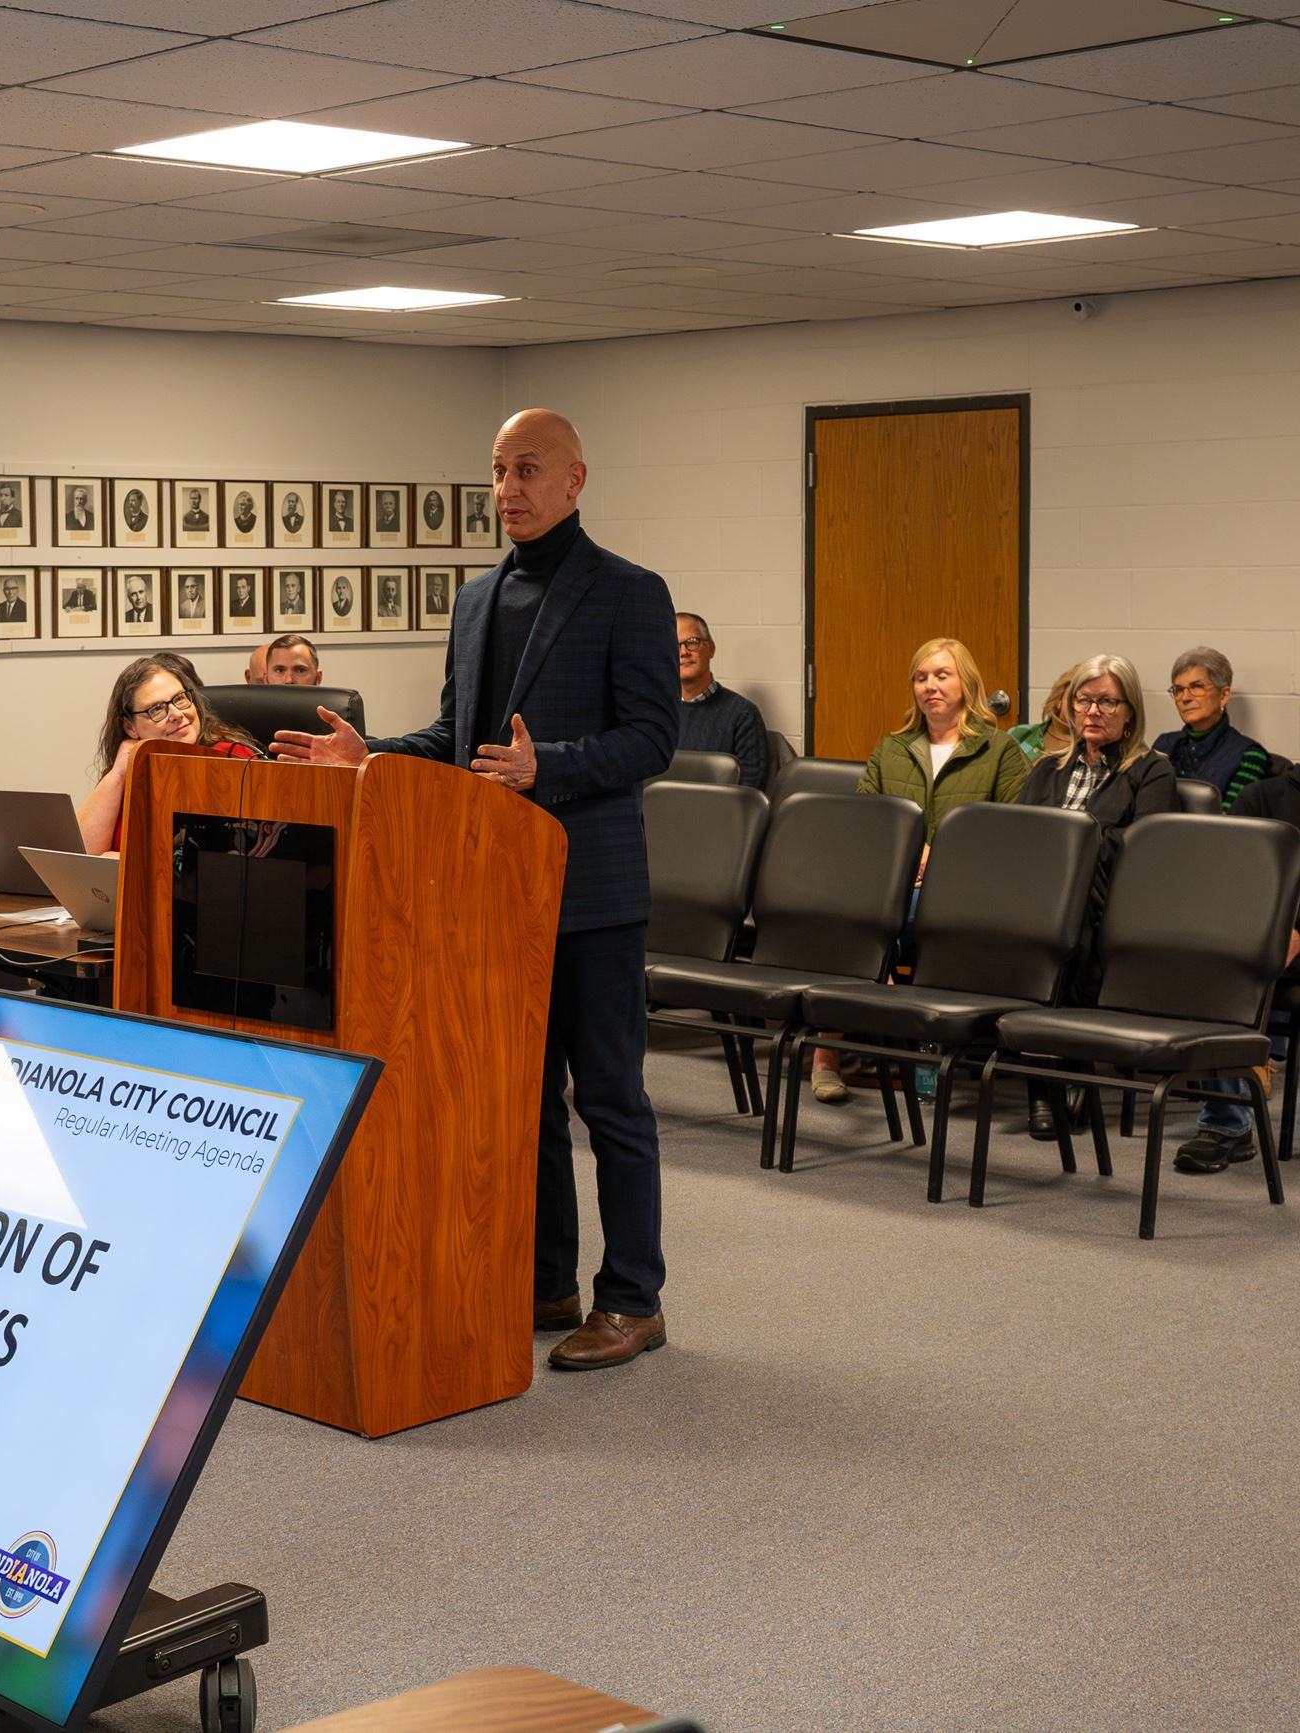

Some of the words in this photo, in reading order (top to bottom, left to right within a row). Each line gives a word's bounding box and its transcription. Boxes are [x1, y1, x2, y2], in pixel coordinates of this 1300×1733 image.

[10, 1055, 105, 1102] DIANOLA
[109, 1080, 168, 1114] CITY
[166, 1092, 279, 1142] COUNCIL
[53, 1107, 120, 1137] Regular
[119, 1122, 192, 1161] Meeting
[191, 1139, 265, 1174] Agenda
[41, 1231, 111, 1292] OF
